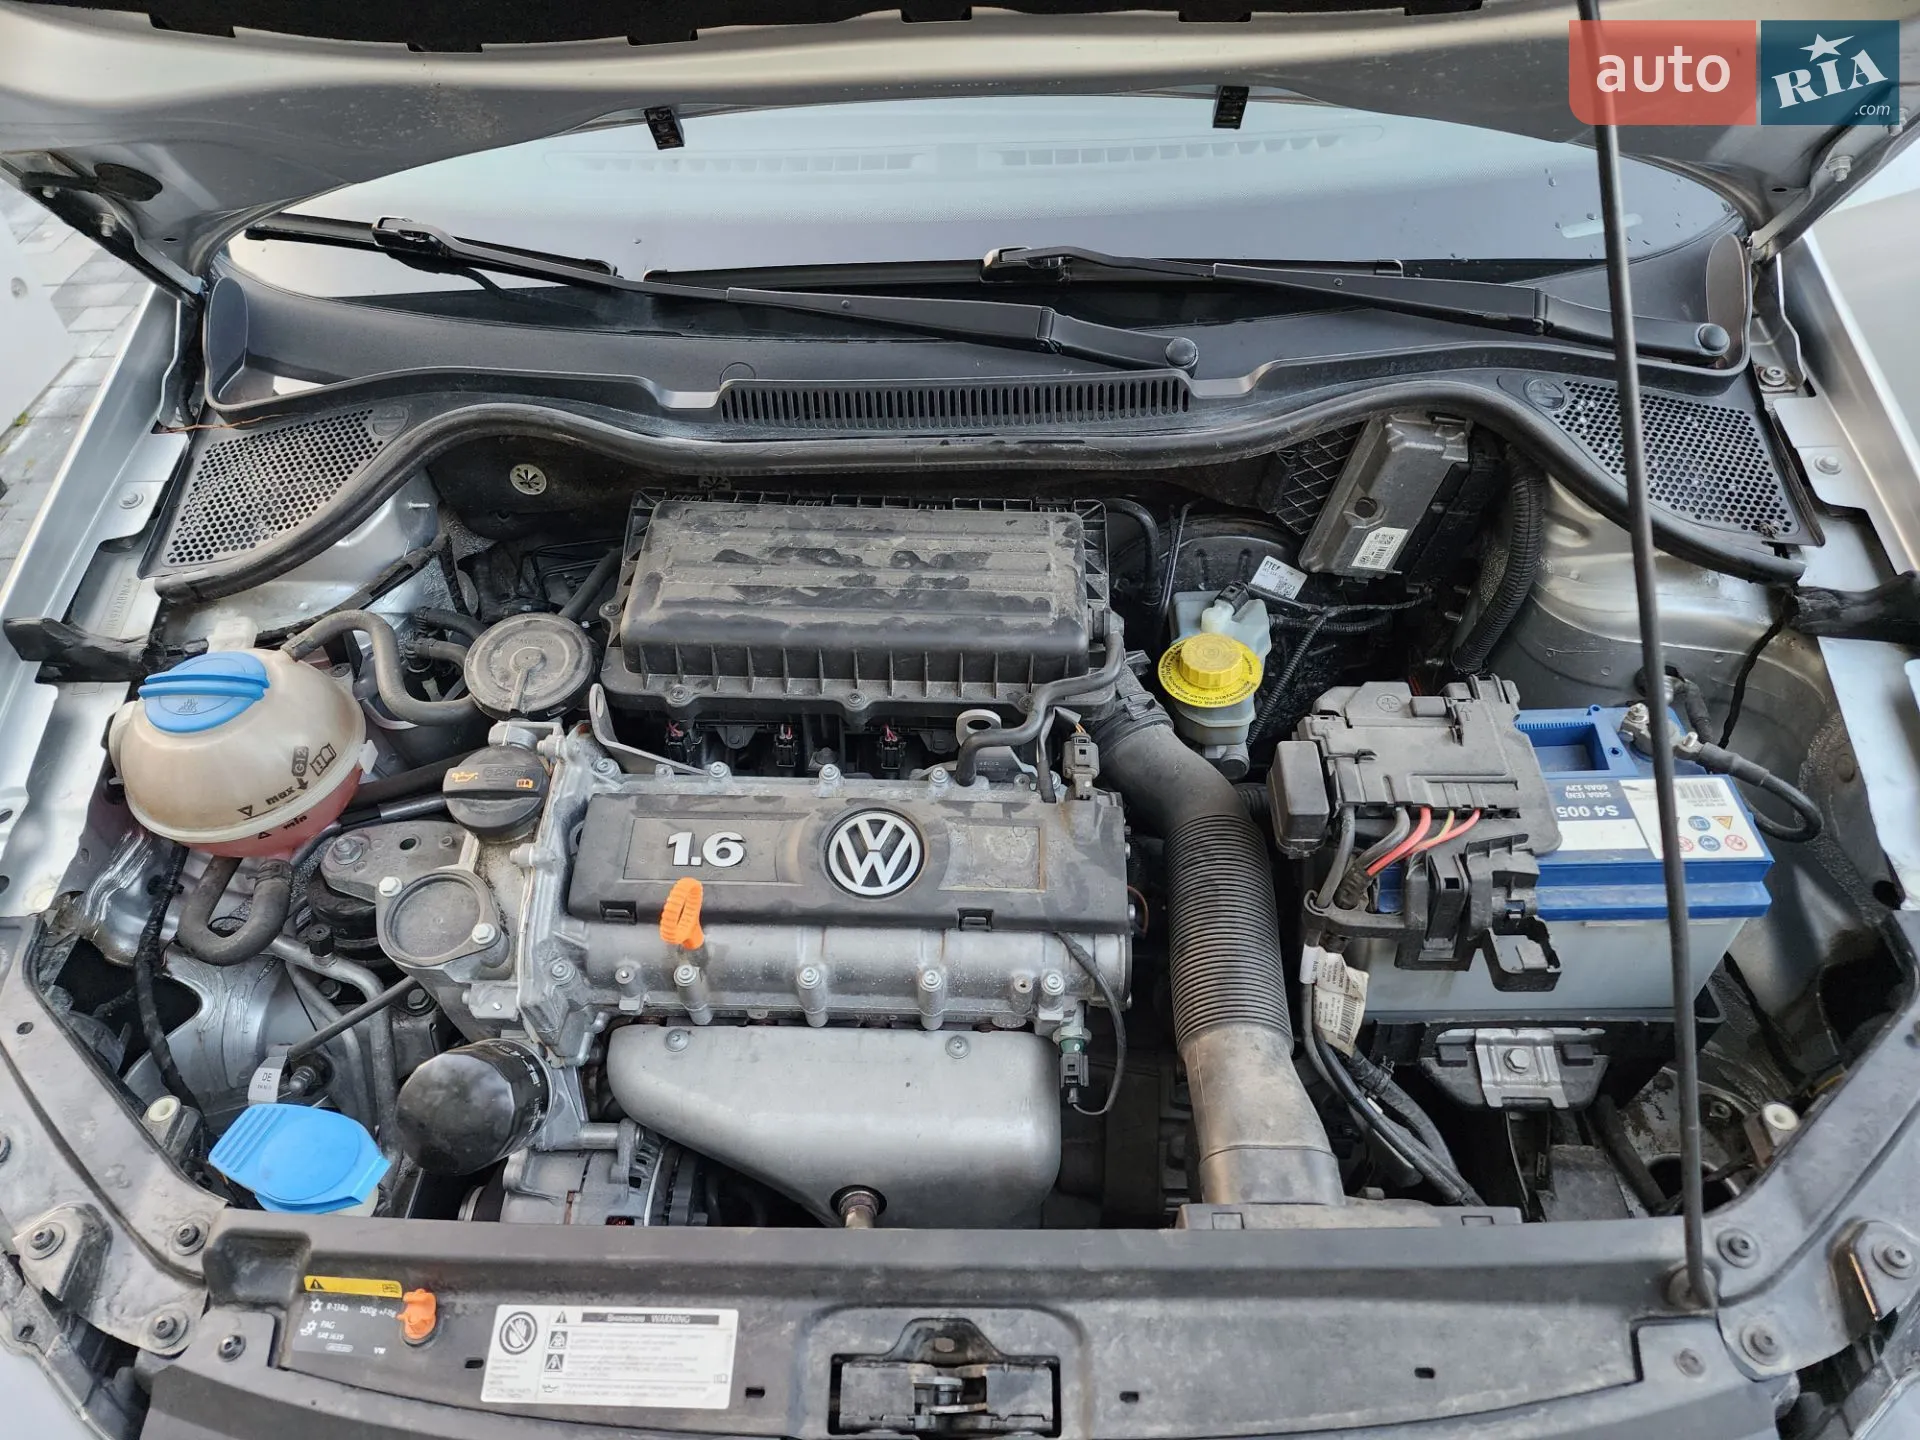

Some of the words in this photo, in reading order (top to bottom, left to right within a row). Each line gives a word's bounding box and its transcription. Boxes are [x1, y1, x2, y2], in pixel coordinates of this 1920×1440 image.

[265, 785, 296, 805] max
[1556, 805, 1591, 818] 005
[1593, 805, 1620, 817] S4
[283, 815, 308, 830] min
[667, 831, 747, 867] 1.6
[651, 1314, 691, 1324] WARNING
